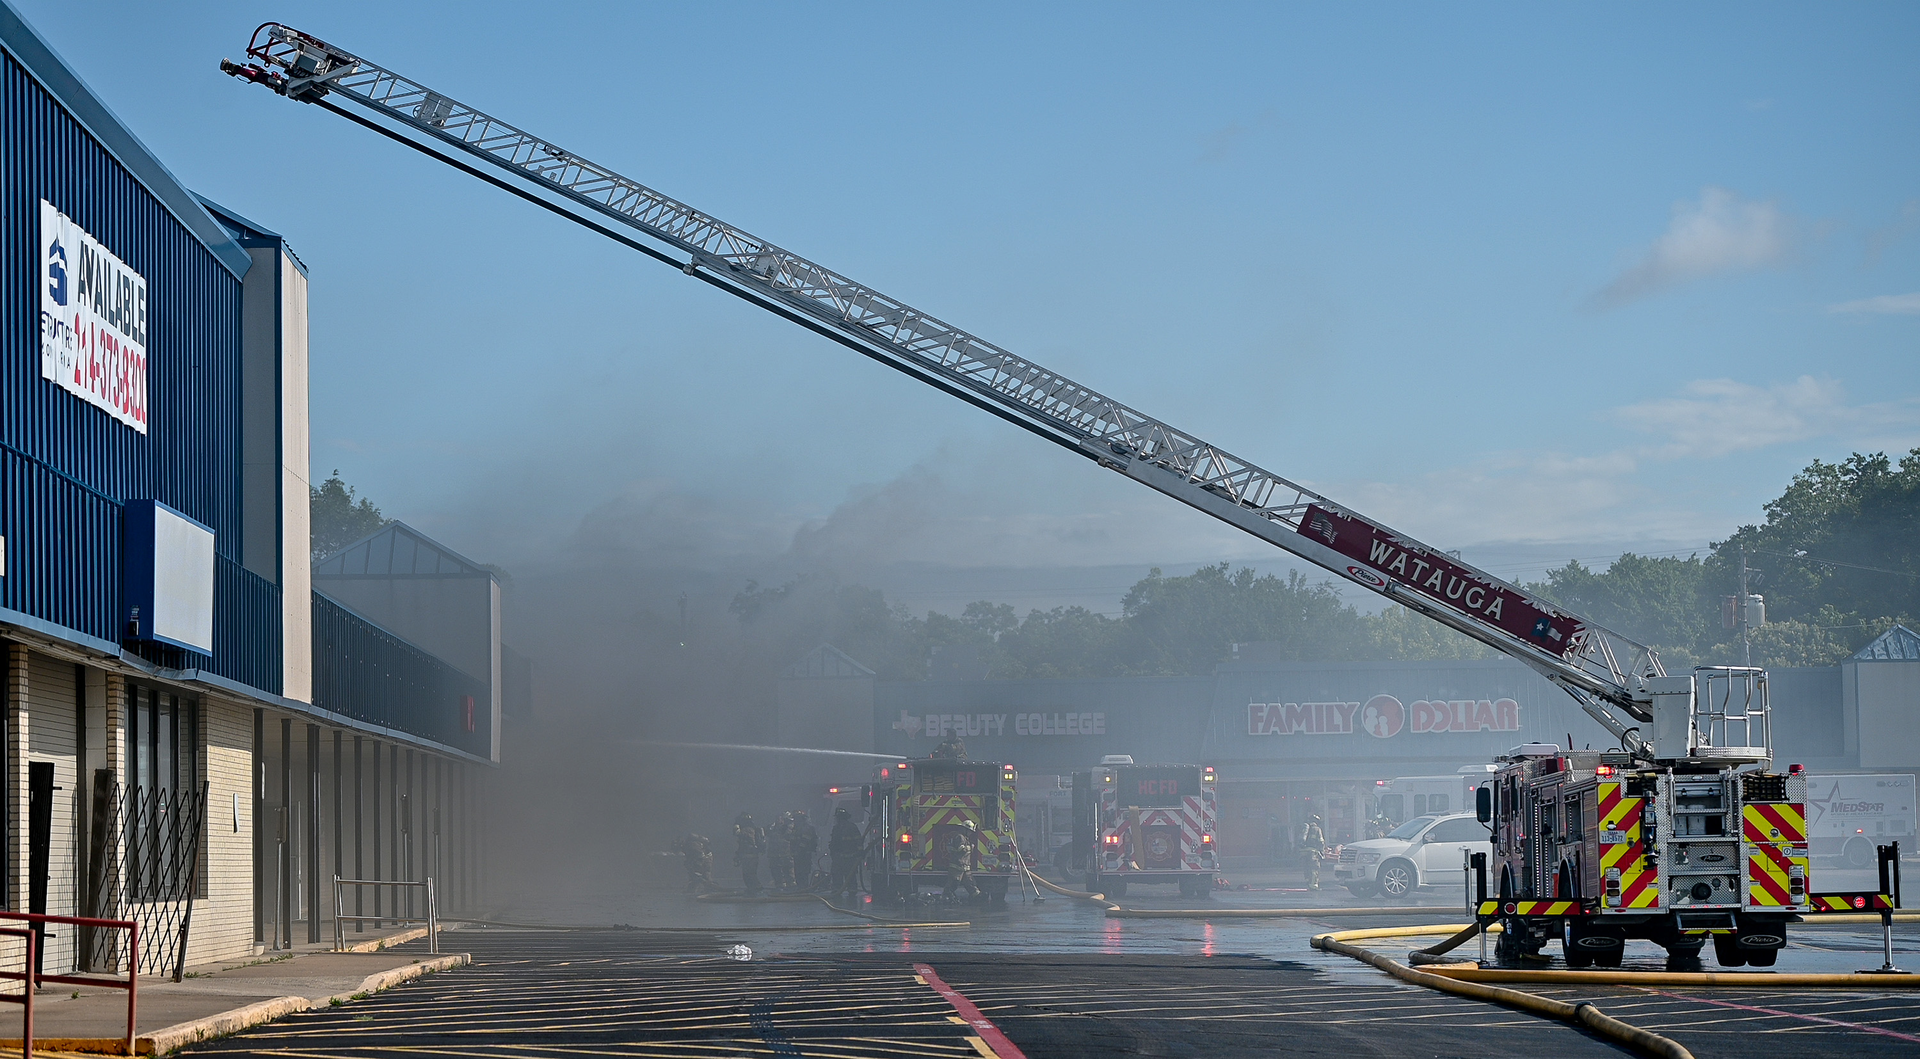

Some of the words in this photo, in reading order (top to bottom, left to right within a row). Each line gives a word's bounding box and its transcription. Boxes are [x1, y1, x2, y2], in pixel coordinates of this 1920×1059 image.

[77, 239, 146, 348] AVAILABLE
[1354, 568, 1377, 583] Pierce
[1368, 538, 1505, 621] WATAUGA
[925, 713, 1007, 737] BEAUTY
[1015, 712, 1106, 735] COLLEGE
[1249, 702, 1360, 735] FAMILY
[1409, 698, 1519, 733] DOLLAR
[957, 771, 976, 787] FD
[1138, 780, 1178, 795] HCFD
